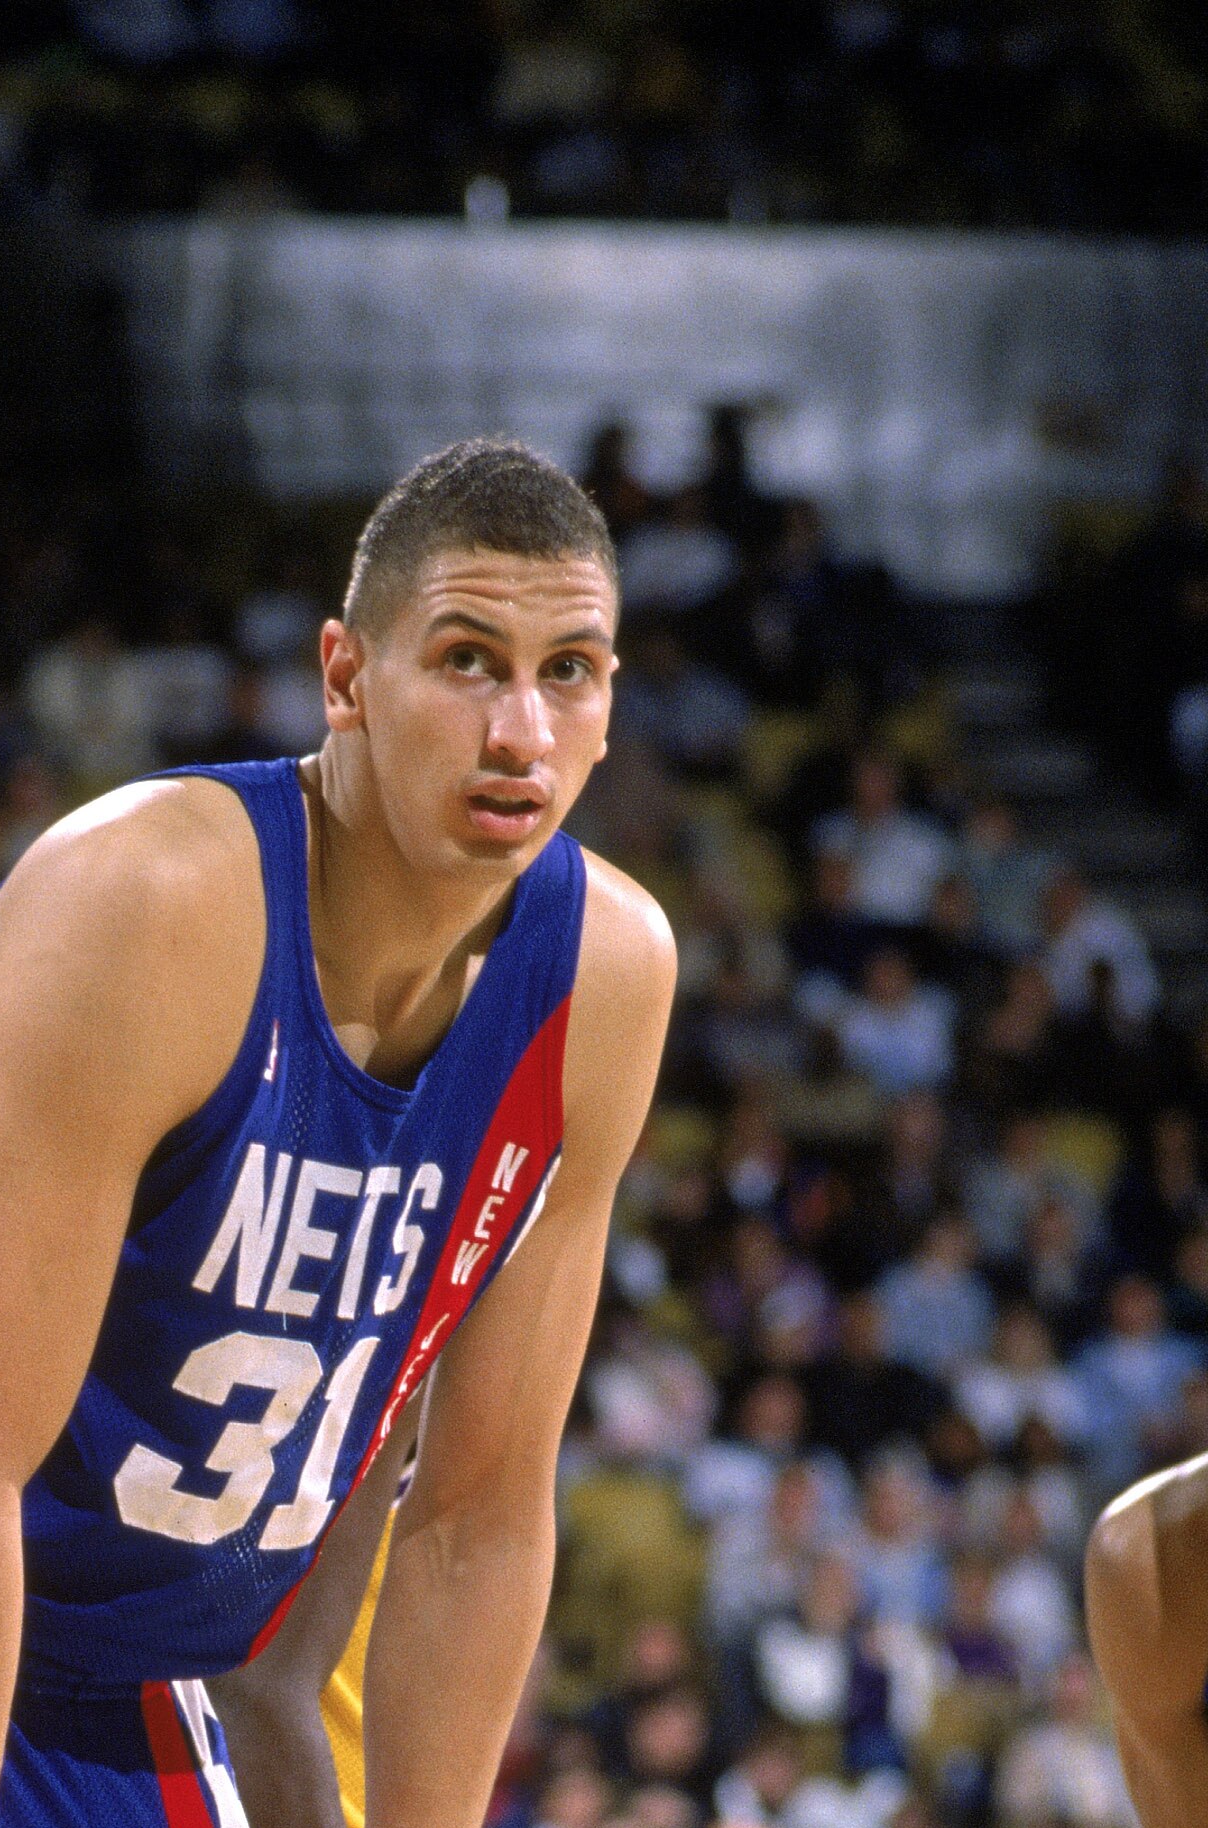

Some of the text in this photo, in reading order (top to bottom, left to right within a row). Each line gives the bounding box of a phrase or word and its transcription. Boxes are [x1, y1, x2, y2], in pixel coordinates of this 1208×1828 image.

[191, 1143, 444, 1320] NETS
[449, 1141, 531, 1286] NEW
[113, 1329, 381, 1551] 31
